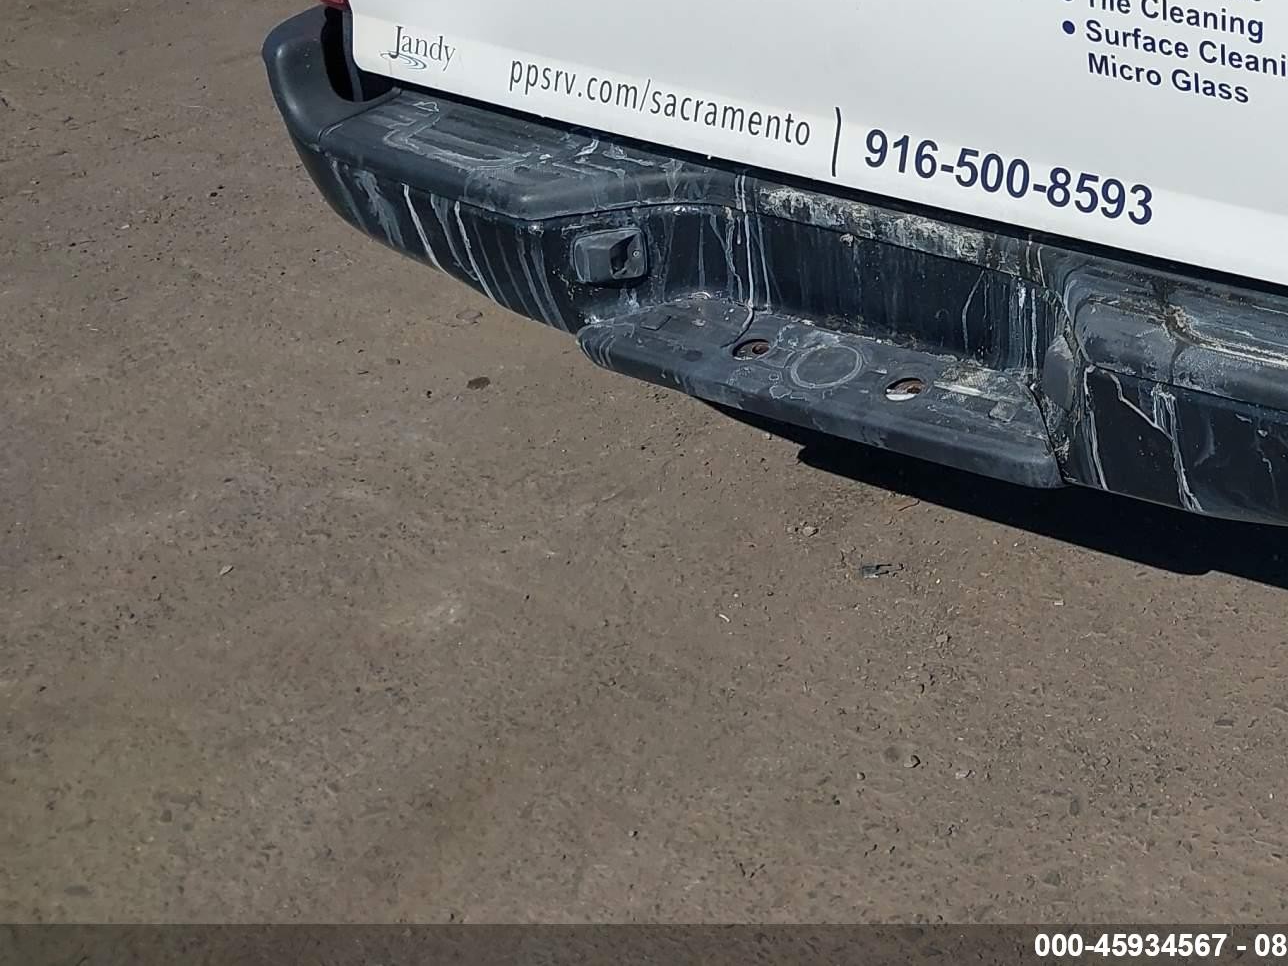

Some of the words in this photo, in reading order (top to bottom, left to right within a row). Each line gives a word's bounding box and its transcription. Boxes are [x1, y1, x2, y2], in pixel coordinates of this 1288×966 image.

[389, 25, 456, 71] Jandy
[1085, 19, 1189, 59] Surface
[509, 59, 811, 147] ppsrv.com/sacramento
[1087, 52, 1162, 85] Micro
[1171, 68, 1249, 103] Glass
[864, 128, 1153, 225] 916-500-8593
